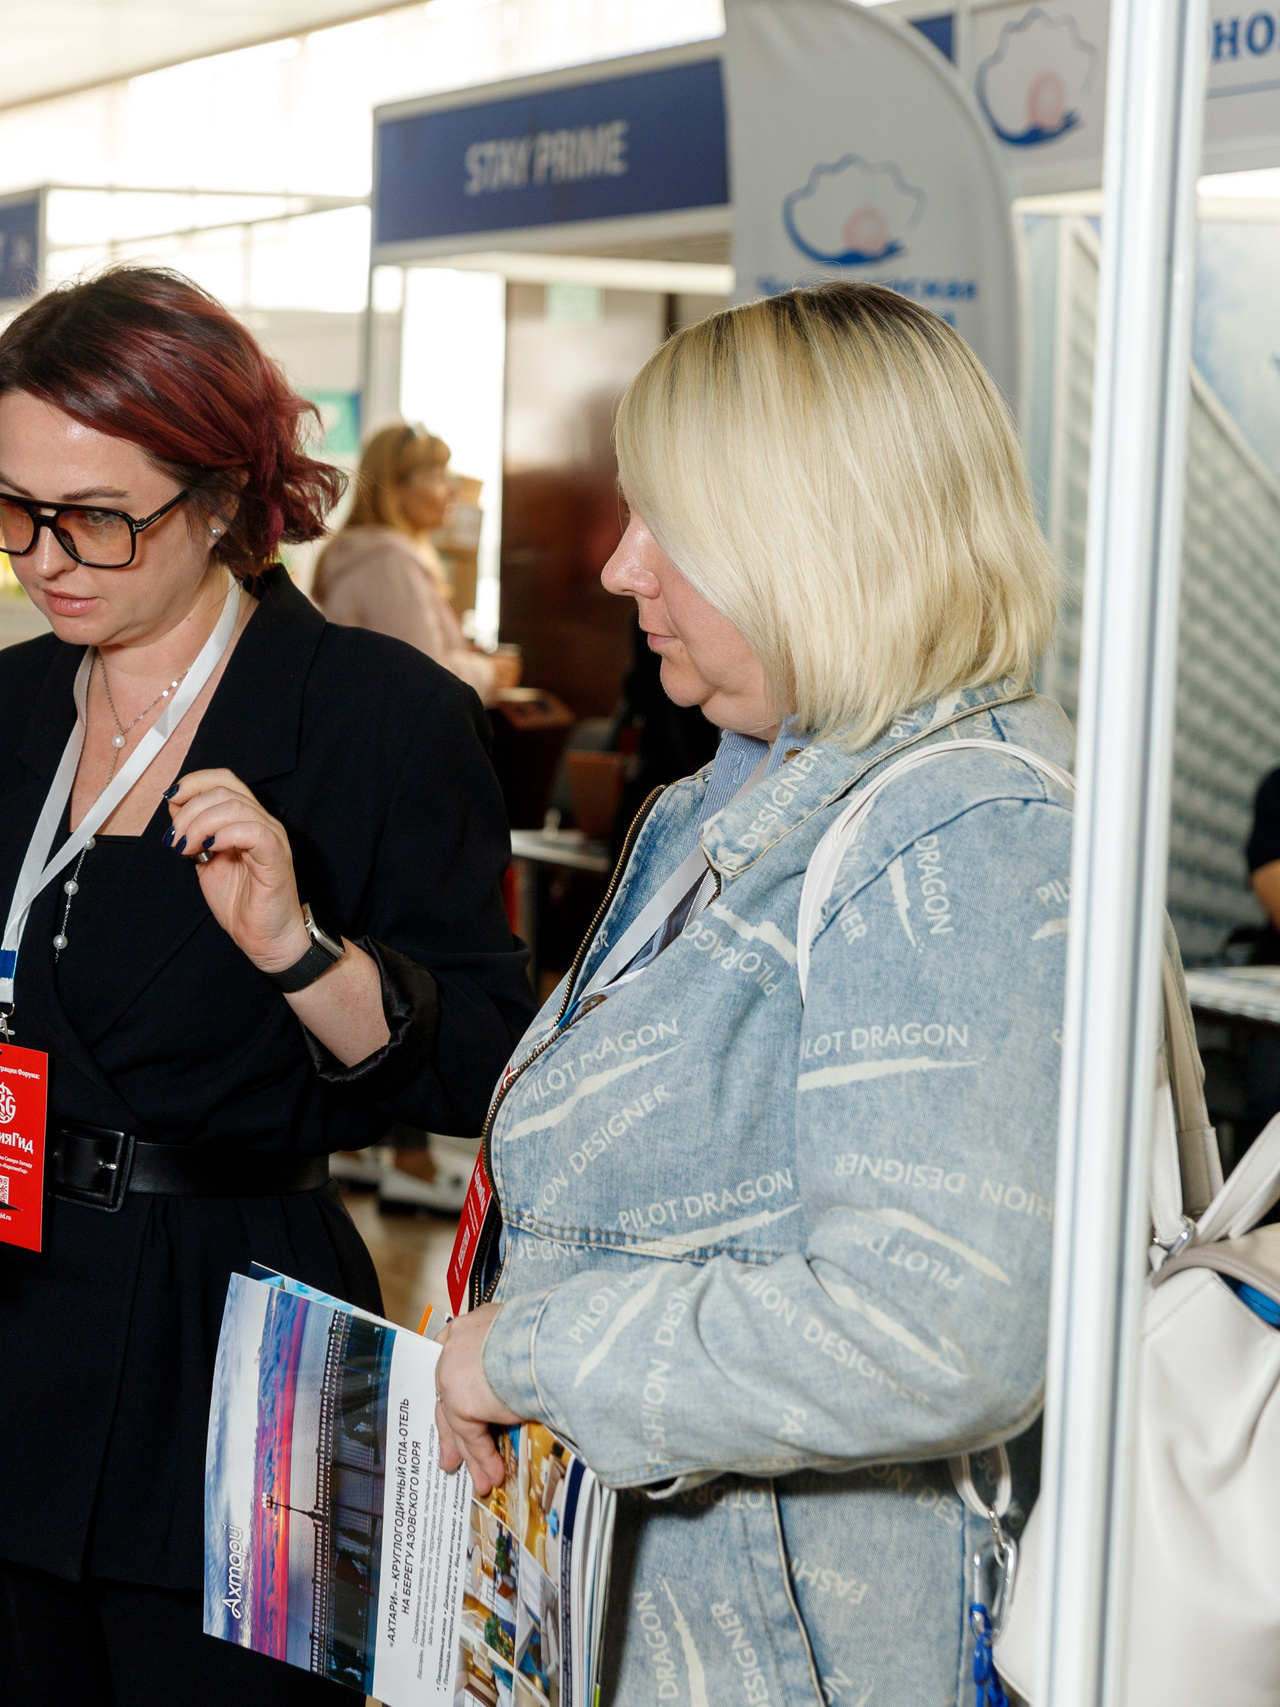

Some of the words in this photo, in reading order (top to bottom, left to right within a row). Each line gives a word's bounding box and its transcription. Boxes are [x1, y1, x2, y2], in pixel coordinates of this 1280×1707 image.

[464, 134, 534, 195] STAY
[533, 120, 628, 185] PRIME
[737, 746, 824, 852] DESIGNER
[914, 834, 956, 935] DRAGON
[800, 1031, 846, 1061] ILOT
[851, 1022, 969, 1051] DRAGON
[522, 1060, 577, 1106] PILOT
[569, 1083, 671, 1176] DESIGNER
[617, 1199, 679, 1233] PILOT
[683, 1167, 795, 1221] DRAGON
[834, 1152, 967, 1194] DESIGNER
[887, 1243, 965, 1292] PILOT
[569, 1285, 618, 1345] PILOT
[396, 1398, 409, 1464] СПА-ОТЕЛЬ
[410, 1440, 420, 1475] МОРЯ
[389, 1466, 407, 1580] КРУГЛОГОДИЧНЫЙ
[406, 1476, 418, 1549] АЗОВСКОГО
[222, 1526, 247, 1618] Ахтари
[402, 1549, 413, 1596] БЕРЕГУ
[791, 1557, 868, 1604] FASHI
[386, 1590, 398, 1647] «АХТАРИ»
[401, 1598, 410, 1614] НА
[435, 1636, 445, 1684] Панорамные
[442, 1554, 453, 1610] Дизайнерский
[636, 1591, 680, 1699] DRAGON
[711, 1599, 770, 1707] ESIGNER
